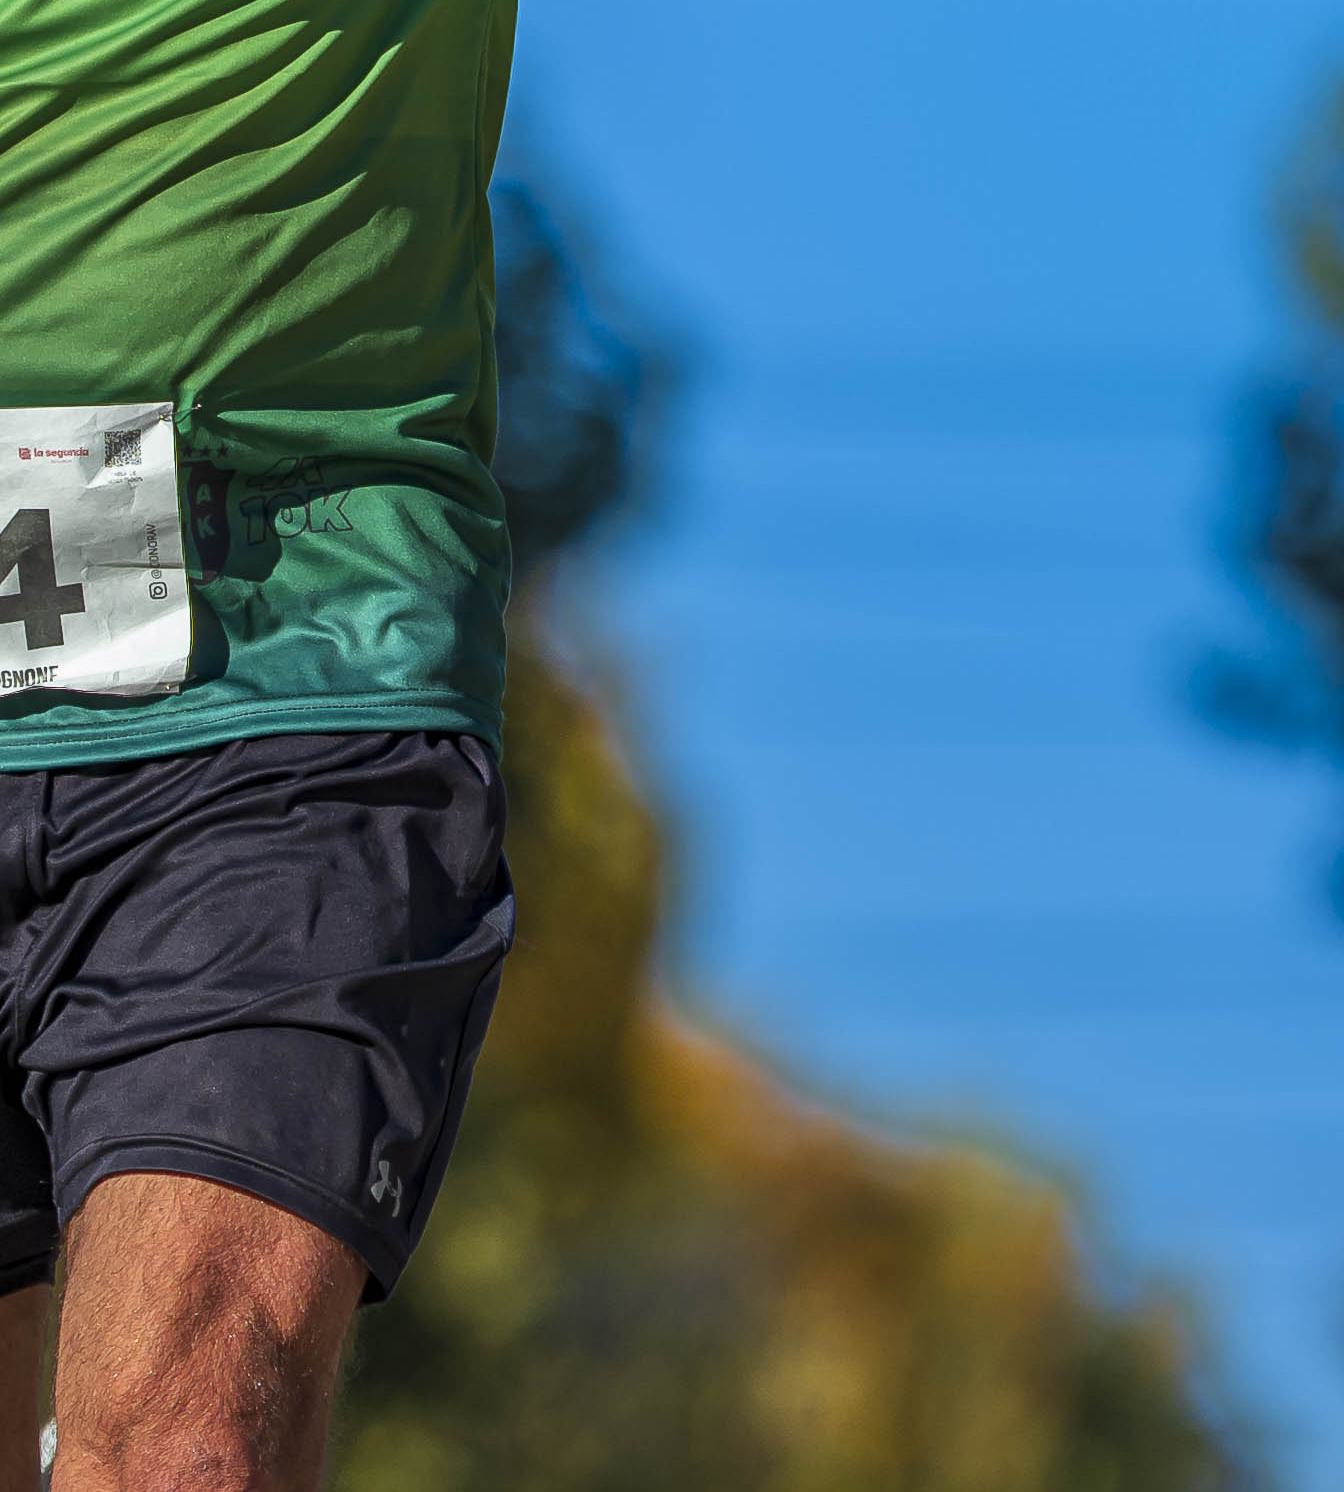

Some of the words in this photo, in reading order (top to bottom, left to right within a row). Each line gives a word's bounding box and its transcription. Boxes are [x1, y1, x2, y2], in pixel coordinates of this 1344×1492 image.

[33, 447, 44, 458] la
[45, 446, 90, 459] segunda
[239, 484, 354, 547] 10K
